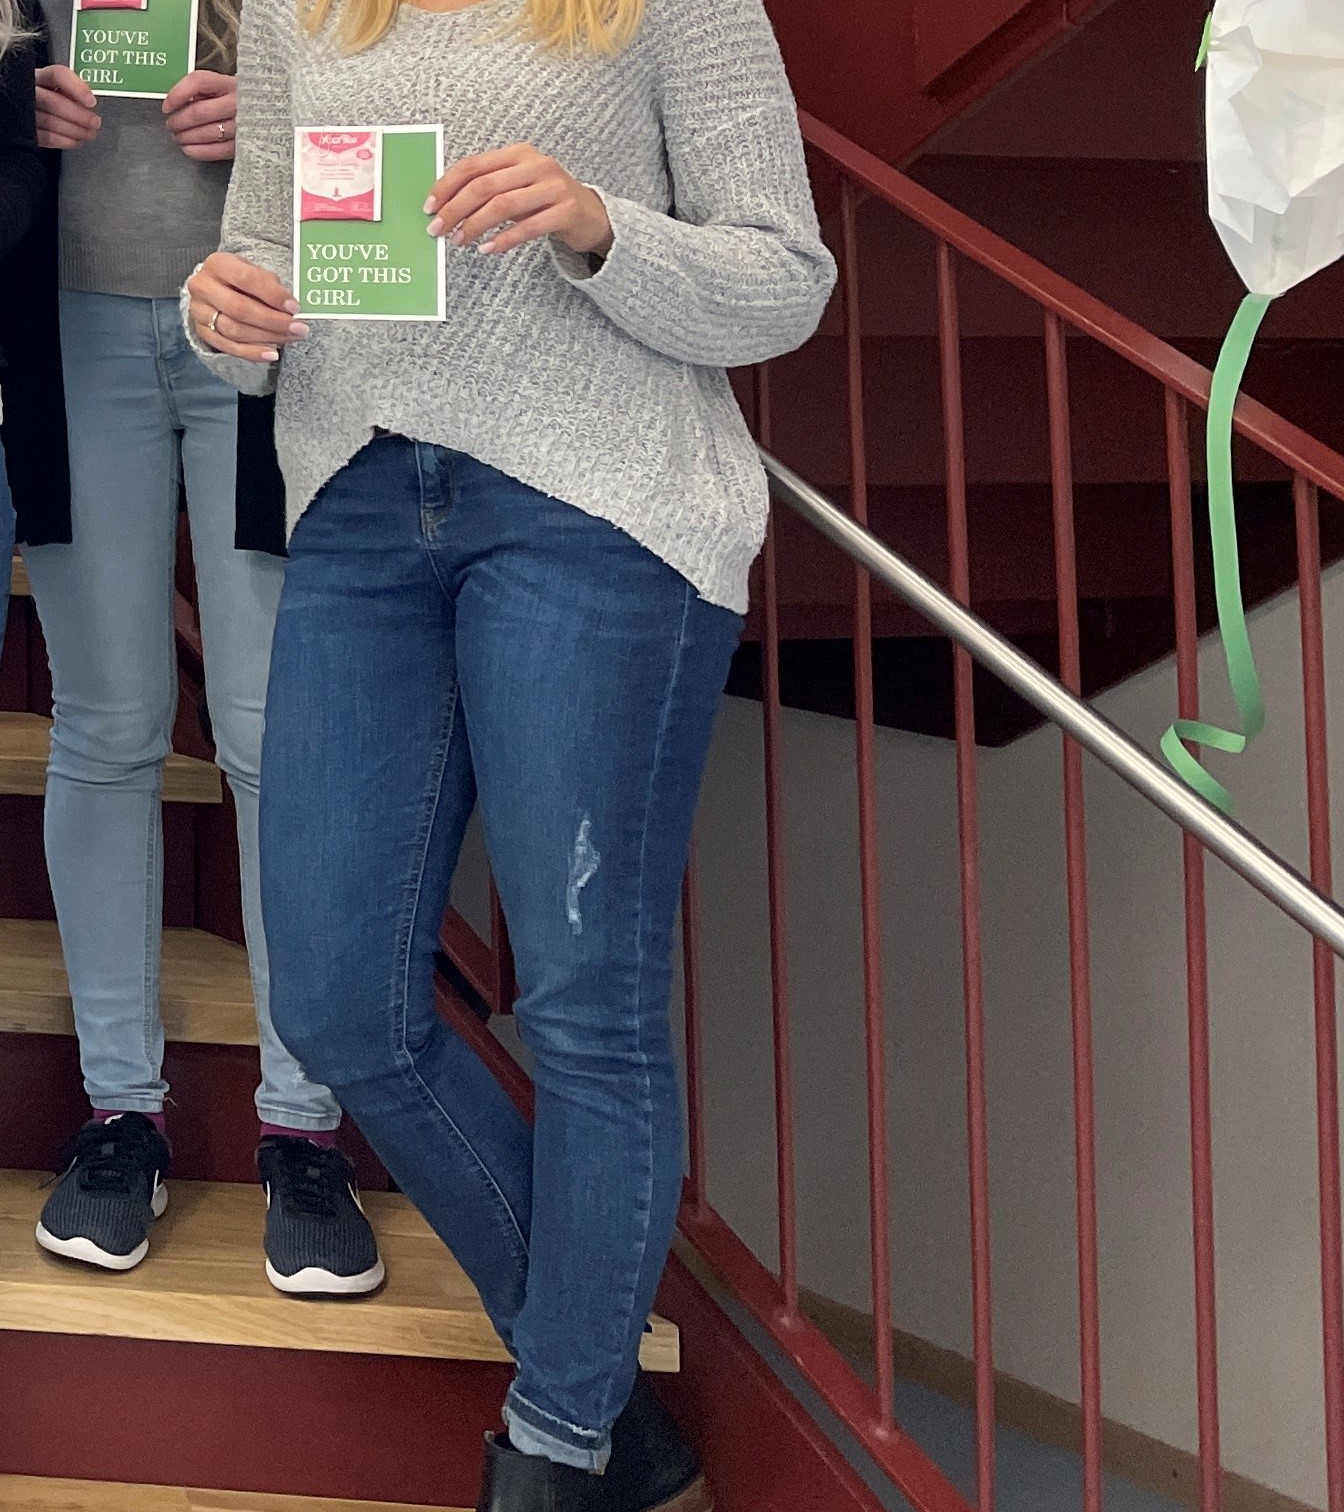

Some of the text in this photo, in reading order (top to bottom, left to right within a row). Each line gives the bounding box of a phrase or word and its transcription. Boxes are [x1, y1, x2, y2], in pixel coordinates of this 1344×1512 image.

[82, 29, 149, 46] YOU'VE
[80, 48, 167, 66] GOT THIS
[79, 69, 124, 84] GIRL
[306, 243, 389, 261] YOU'VE
[306, 266, 412, 284] GOT THIS
[306, 289, 361, 306] GIRL
